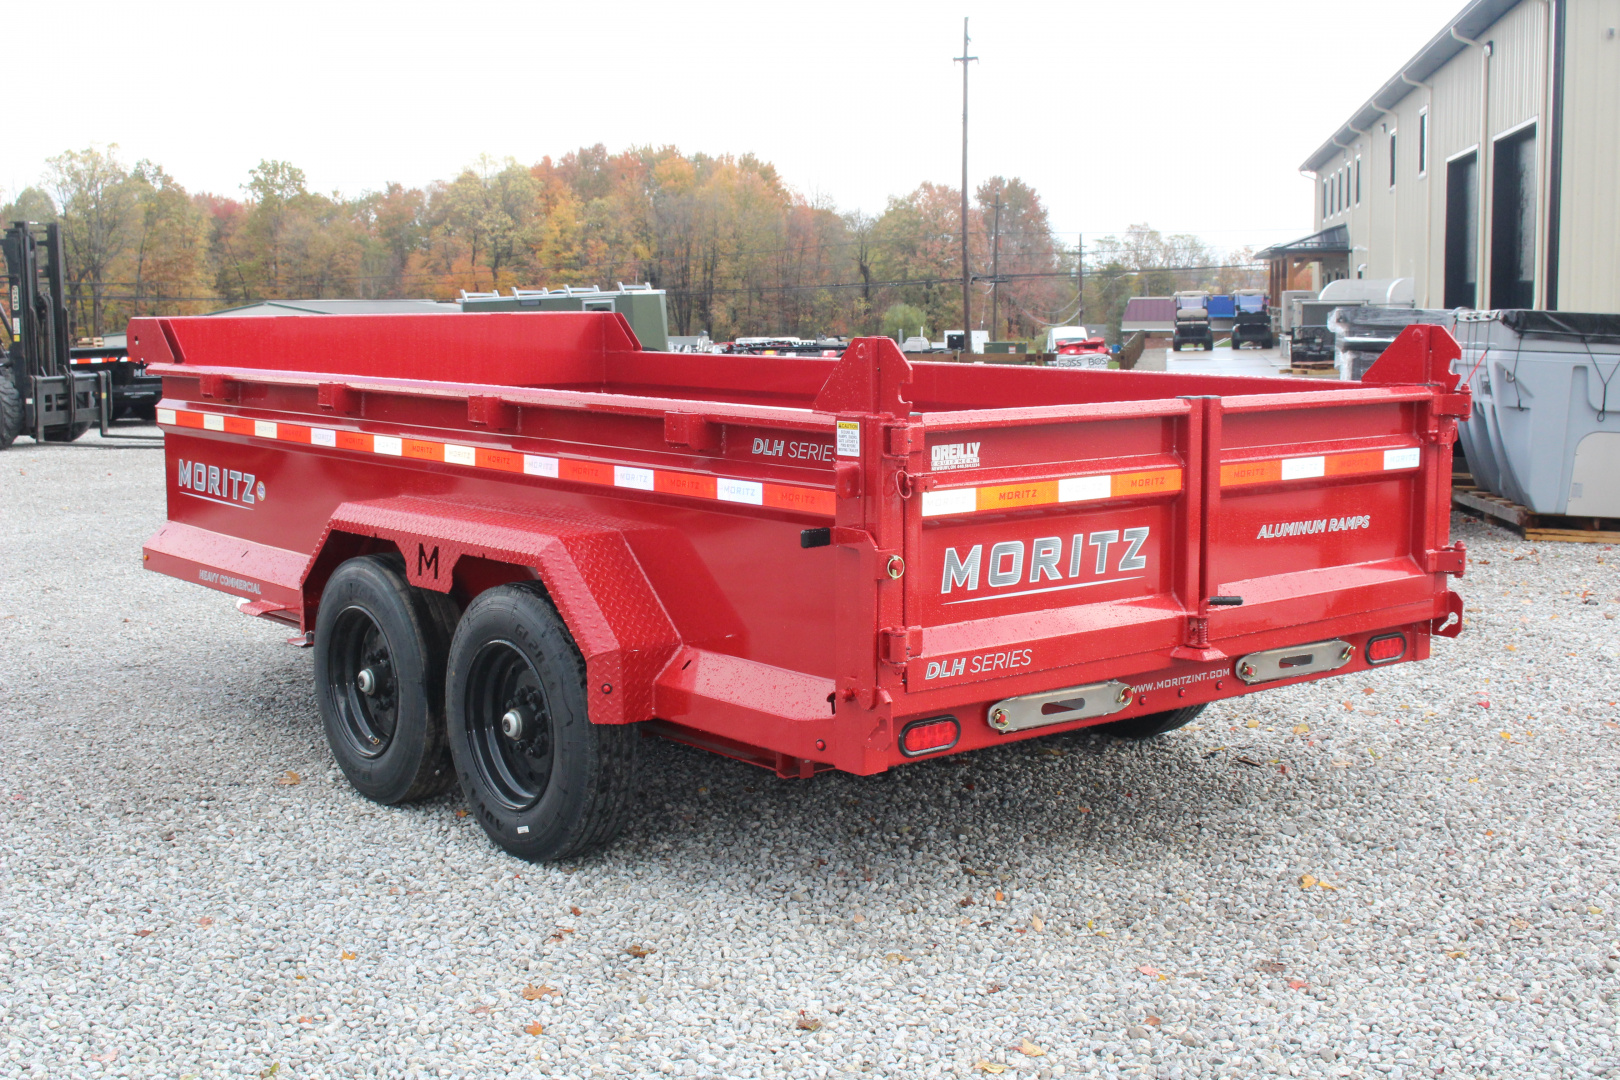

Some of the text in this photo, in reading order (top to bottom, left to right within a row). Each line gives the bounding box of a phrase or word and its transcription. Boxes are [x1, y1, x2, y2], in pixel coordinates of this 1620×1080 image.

[752, 437, 785, 457] DLH
[178, 458, 256, 505] MORITZ
[412, 445, 433, 454] MORITZ
[487, 454, 511, 465] MORITZ
[572, 466, 599, 477] MORITZ
[619, 472, 648, 483] MORITZ
[670, 479, 700, 490] MORITZ
[723, 485, 756, 497] MORITZ
[781, 492, 816, 504] MORITZ
[1234, 468, 1265, 478] MORITZ
[998, 489, 1038, 501] MORITZ
[1130, 476, 1165, 487] MORITZ
[1256, 514, 1371, 540] ALUMINUM RAMPS
[418, 542, 439, 580] M
[940, 526, 1150, 594] MORITZ
[198, 569, 262, 595] HEAVY COMMERCIAL
[925, 648, 1033, 680] DLH SERIES
